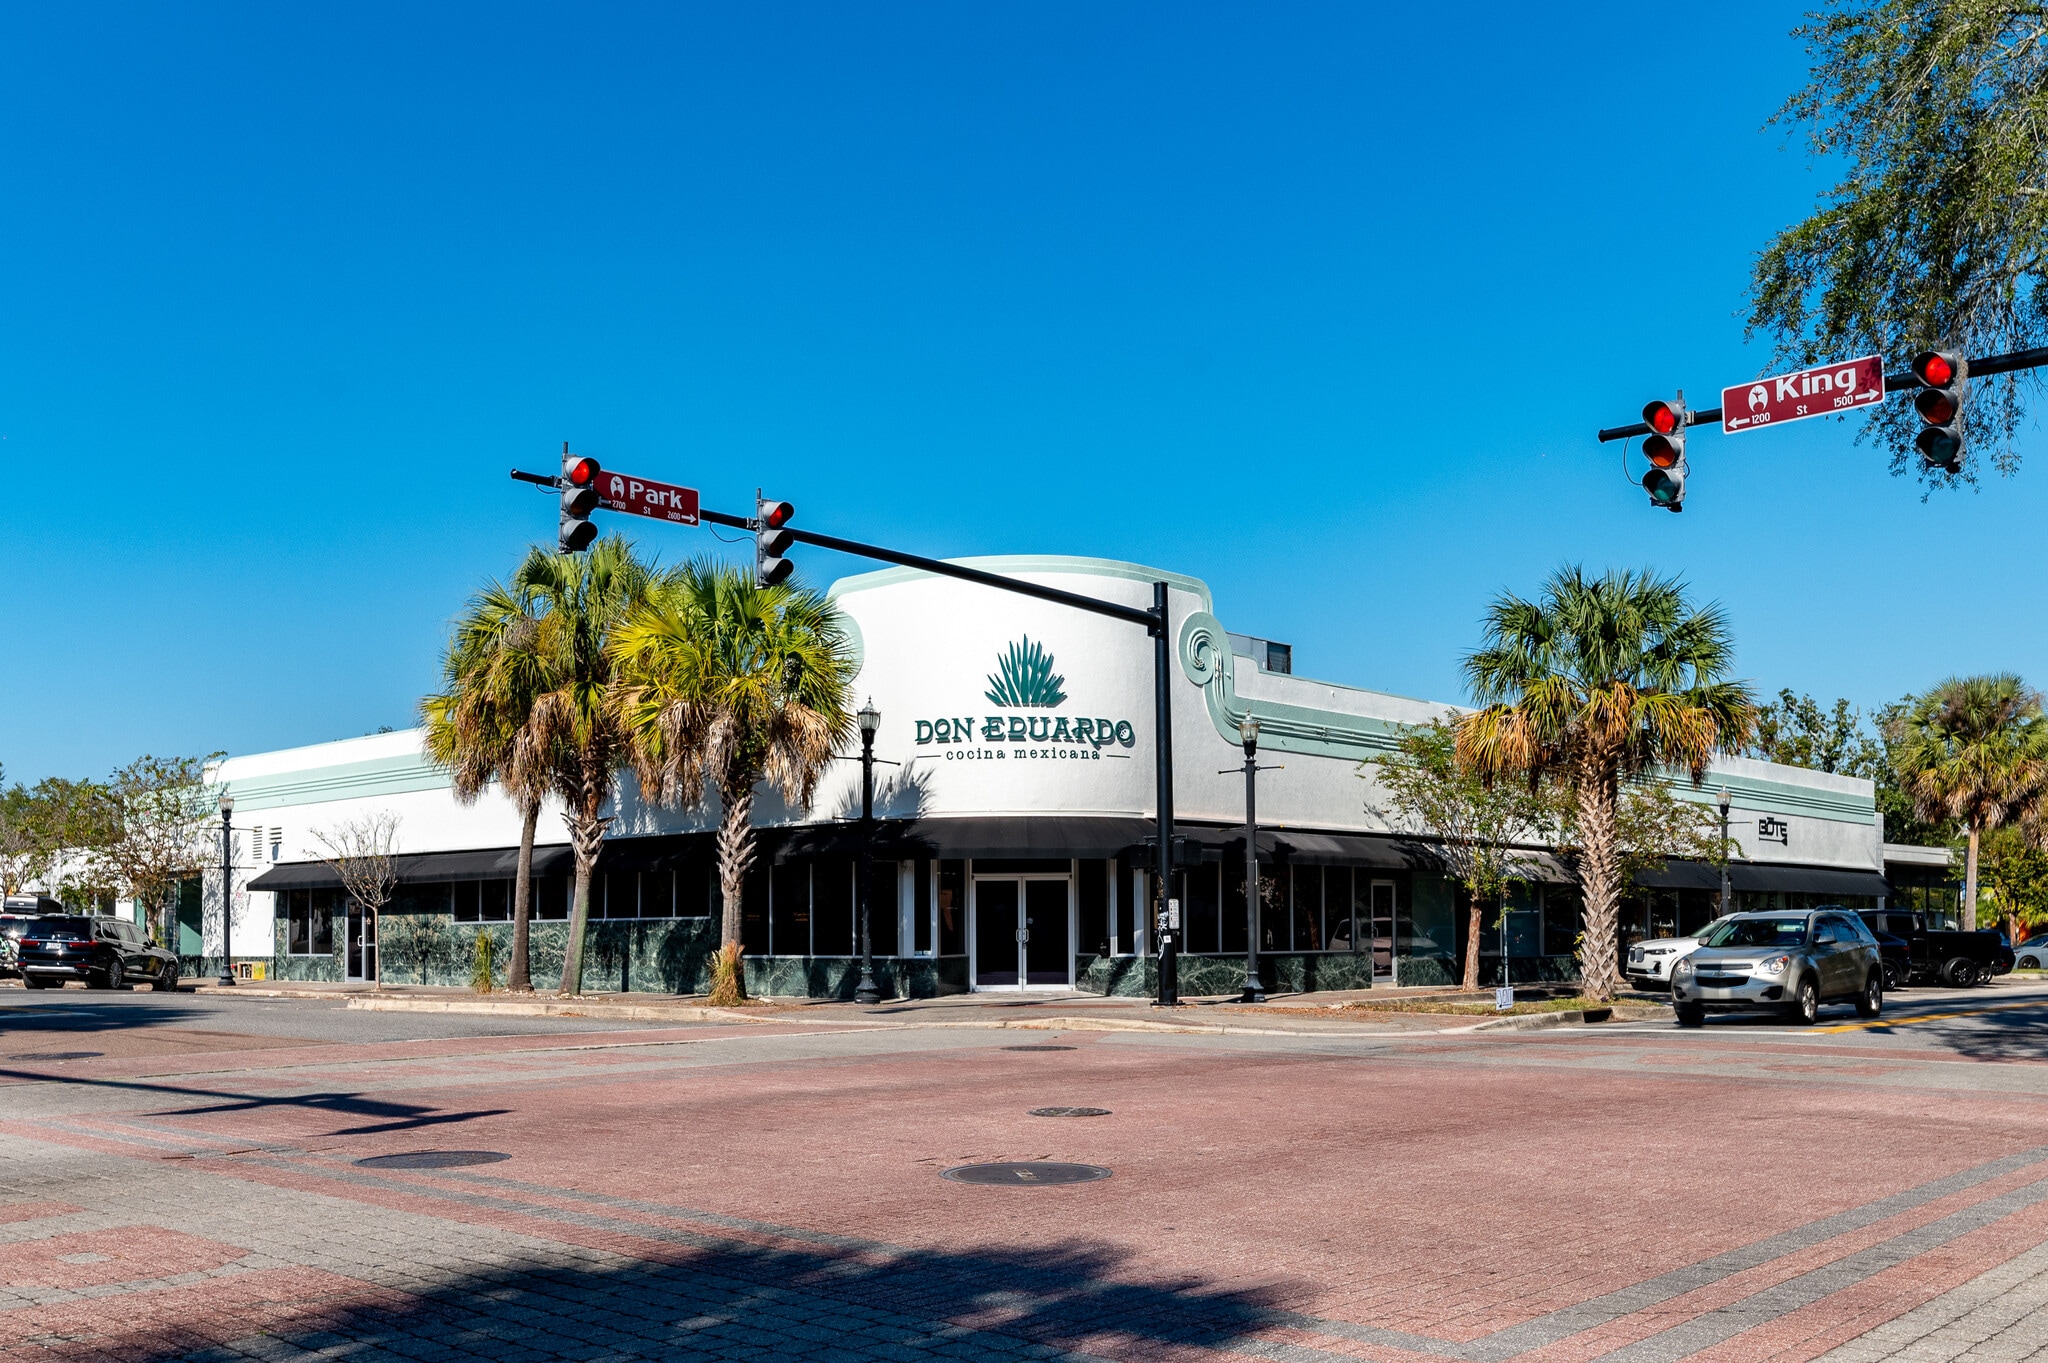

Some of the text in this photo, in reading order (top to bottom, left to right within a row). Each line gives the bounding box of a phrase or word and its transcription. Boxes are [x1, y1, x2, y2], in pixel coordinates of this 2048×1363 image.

[1776, 367, 1857, 402] King
[1833, 395, 1853, 408] 1500
[1796, 404, 1807, 415] St
[1752, 411, 1770, 424] 1200
[629, 480, 682, 509] Park
[612, 500, 626, 510] 2700
[643, 506, 651, 515] St
[667, 511, 680, 521] 2600
[915, 717, 1135, 750] DON EDUARDO
[946, 747, 1101, 760] cocina mexicana
